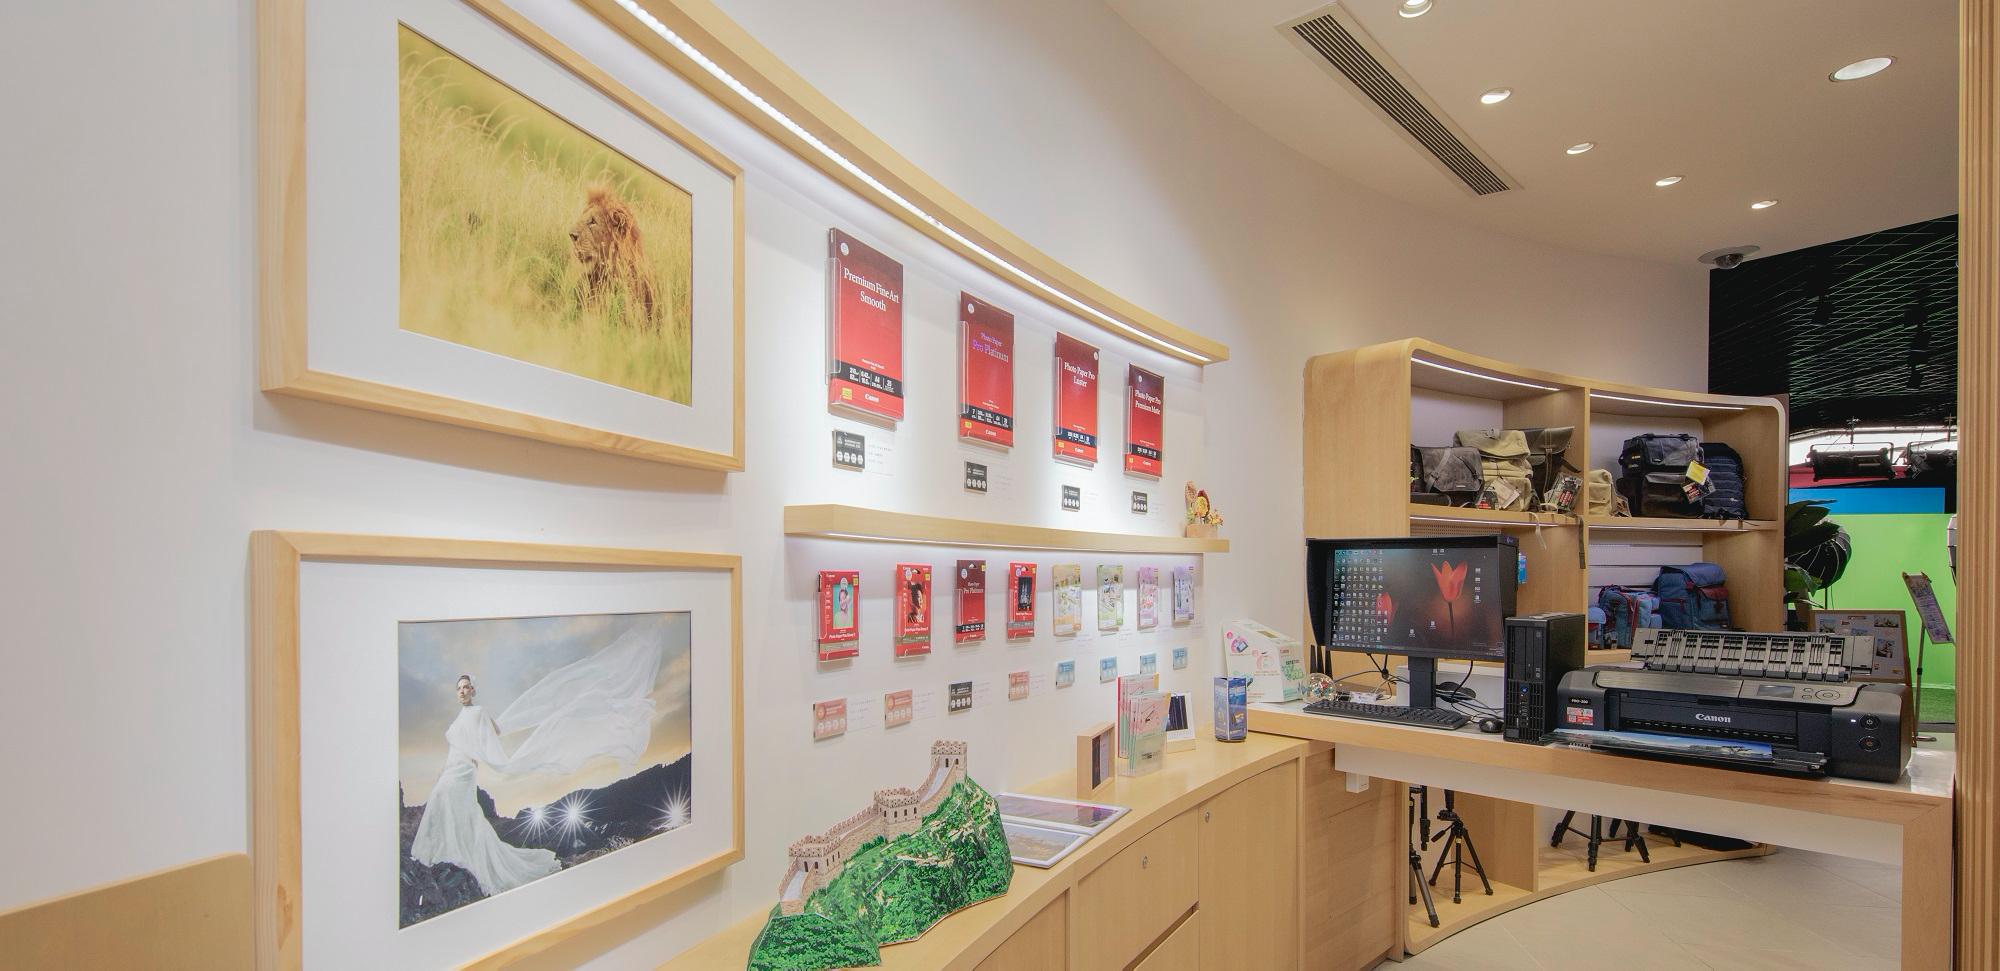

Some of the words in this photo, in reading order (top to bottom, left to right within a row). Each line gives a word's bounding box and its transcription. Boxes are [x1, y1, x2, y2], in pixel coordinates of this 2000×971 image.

[844, 267, 876, 292] Premium
[876, 282, 890, 298] Fine
[889, 290, 900, 303] Art
[861, 291, 886, 311] Smooth
[972, 339, 984, 353] Pro
[984, 344, 1008, 363] Platinum
[1064, 361, 1077, 372] Photo
[1077, 366, 1088, 378] Paper
[1074, 376, 1087, 387] Luster
[864, 393, 880, 403] Canon
[1135, 390, 1146, 399] Photo
[1145, 392, 1155, 403] Paper
[985, 429, 997, 437] Canon
[1695, 713, 1731, 723] Canon
